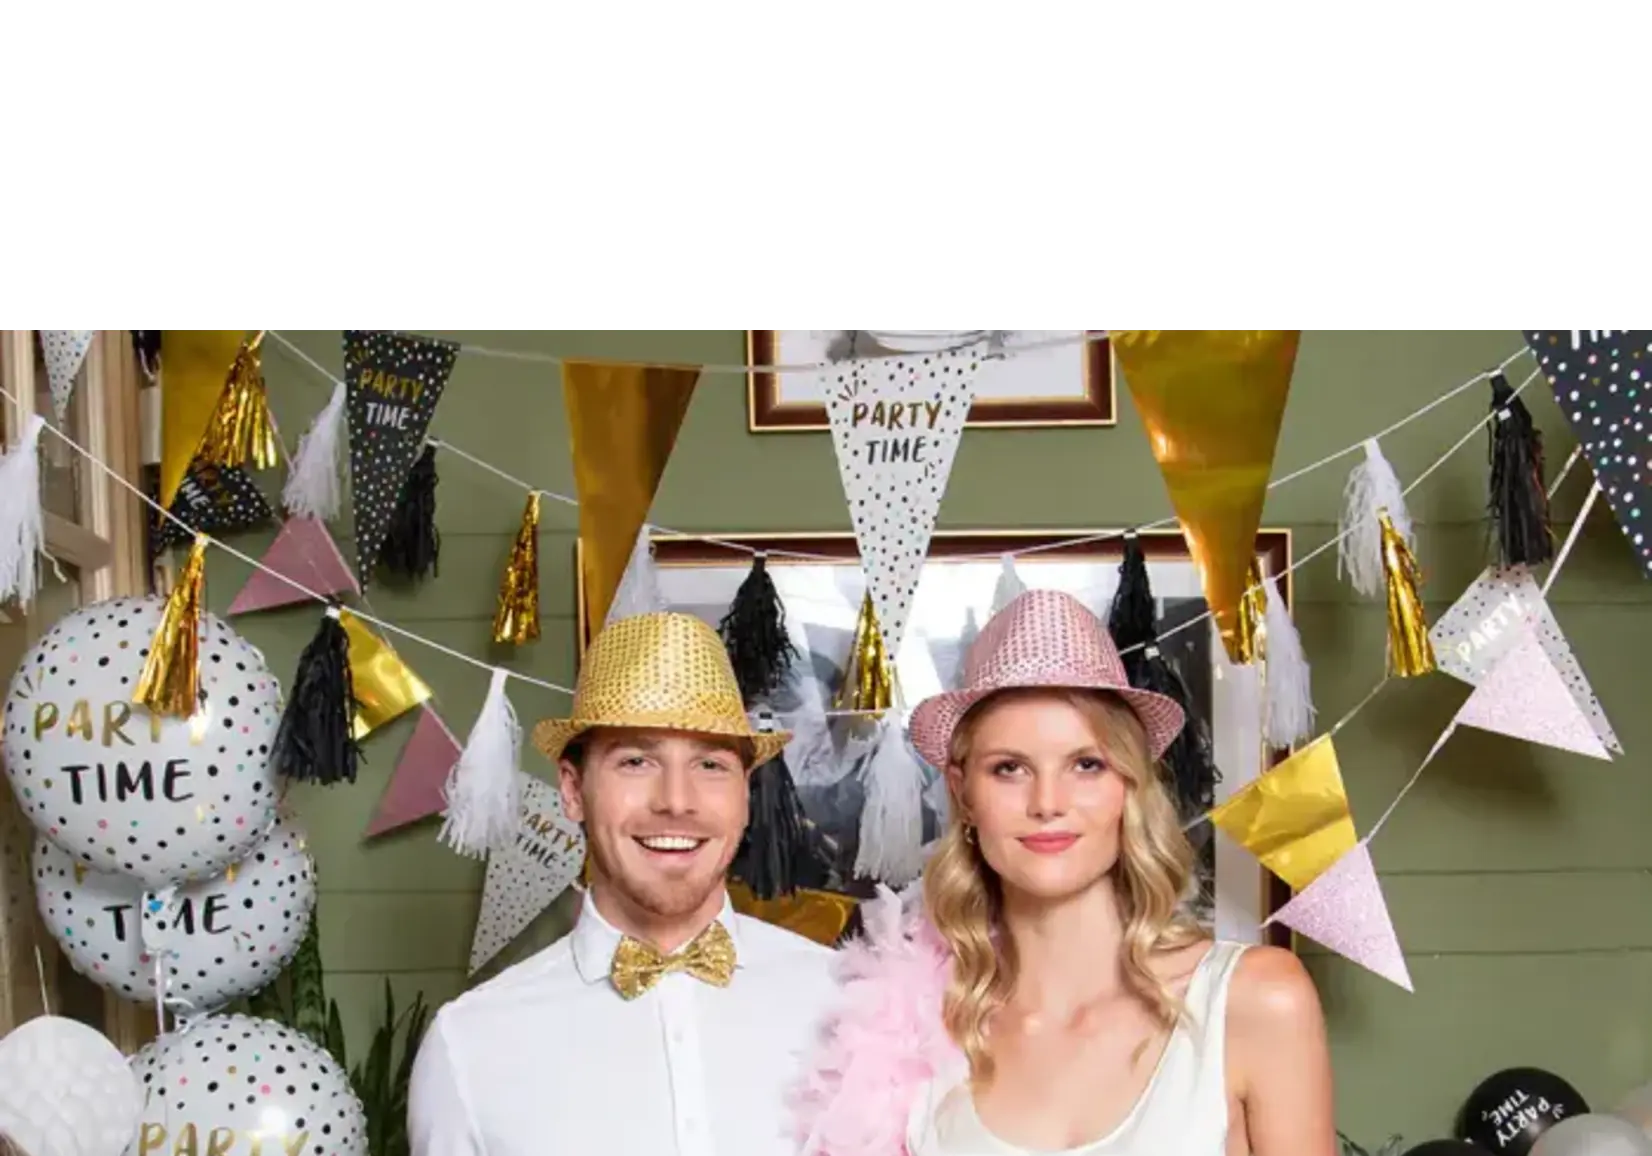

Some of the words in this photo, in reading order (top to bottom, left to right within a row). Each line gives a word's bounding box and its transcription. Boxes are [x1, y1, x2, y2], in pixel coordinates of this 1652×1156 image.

[359, 367, 424, 404] PARTY
[365, 401, 411, 430] TIME
[852, 399, 942, 431] PARTY
[866, 435, 927, 465] TIME
[1455, 592, 1522, 664] PARTY
[60, 758, 194, 805] TIME
[515, 831, 559, 869] TIME
[103, 893, 232, 942] TME
[1489, 1089, 1530, 1126] TIME
[1496, 1096, 1551, 1148] PARTY
